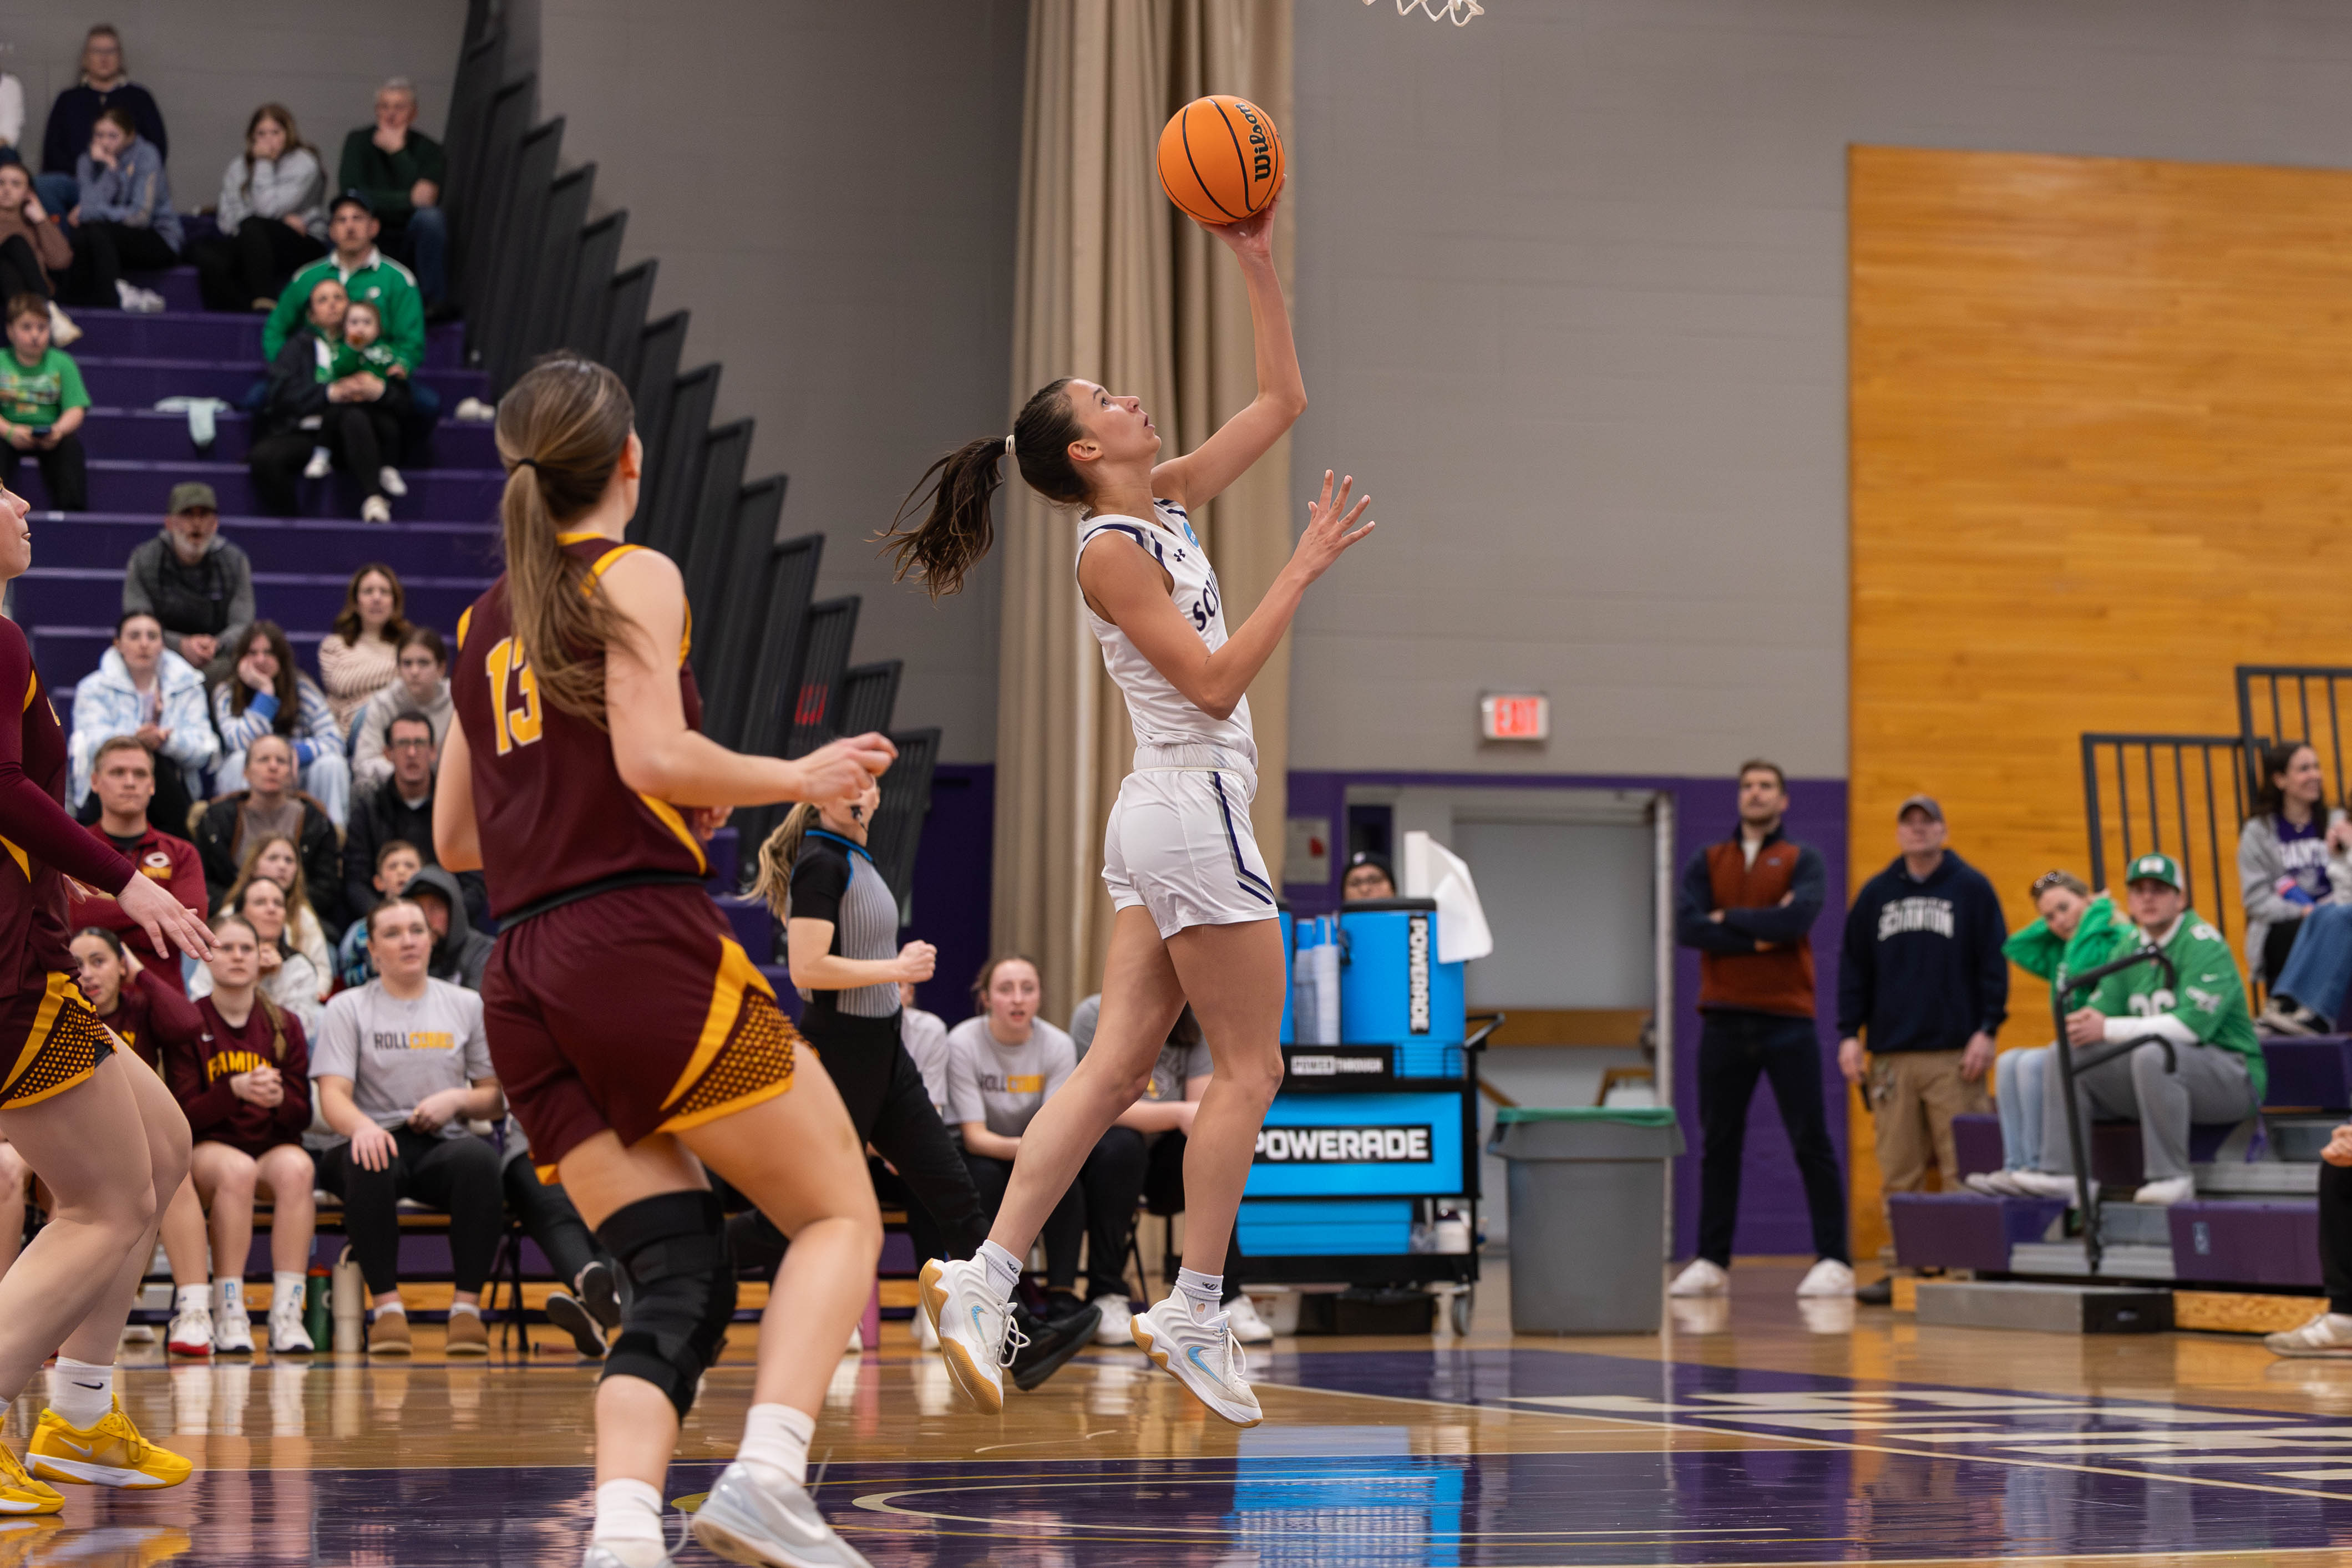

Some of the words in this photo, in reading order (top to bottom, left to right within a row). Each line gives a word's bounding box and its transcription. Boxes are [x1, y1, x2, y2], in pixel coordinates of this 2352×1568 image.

[1235, 103, 1271, 182] Wilson
[485, 636, 543, 757] 13
[1410, 919, 1429, 1031] POWERADE
